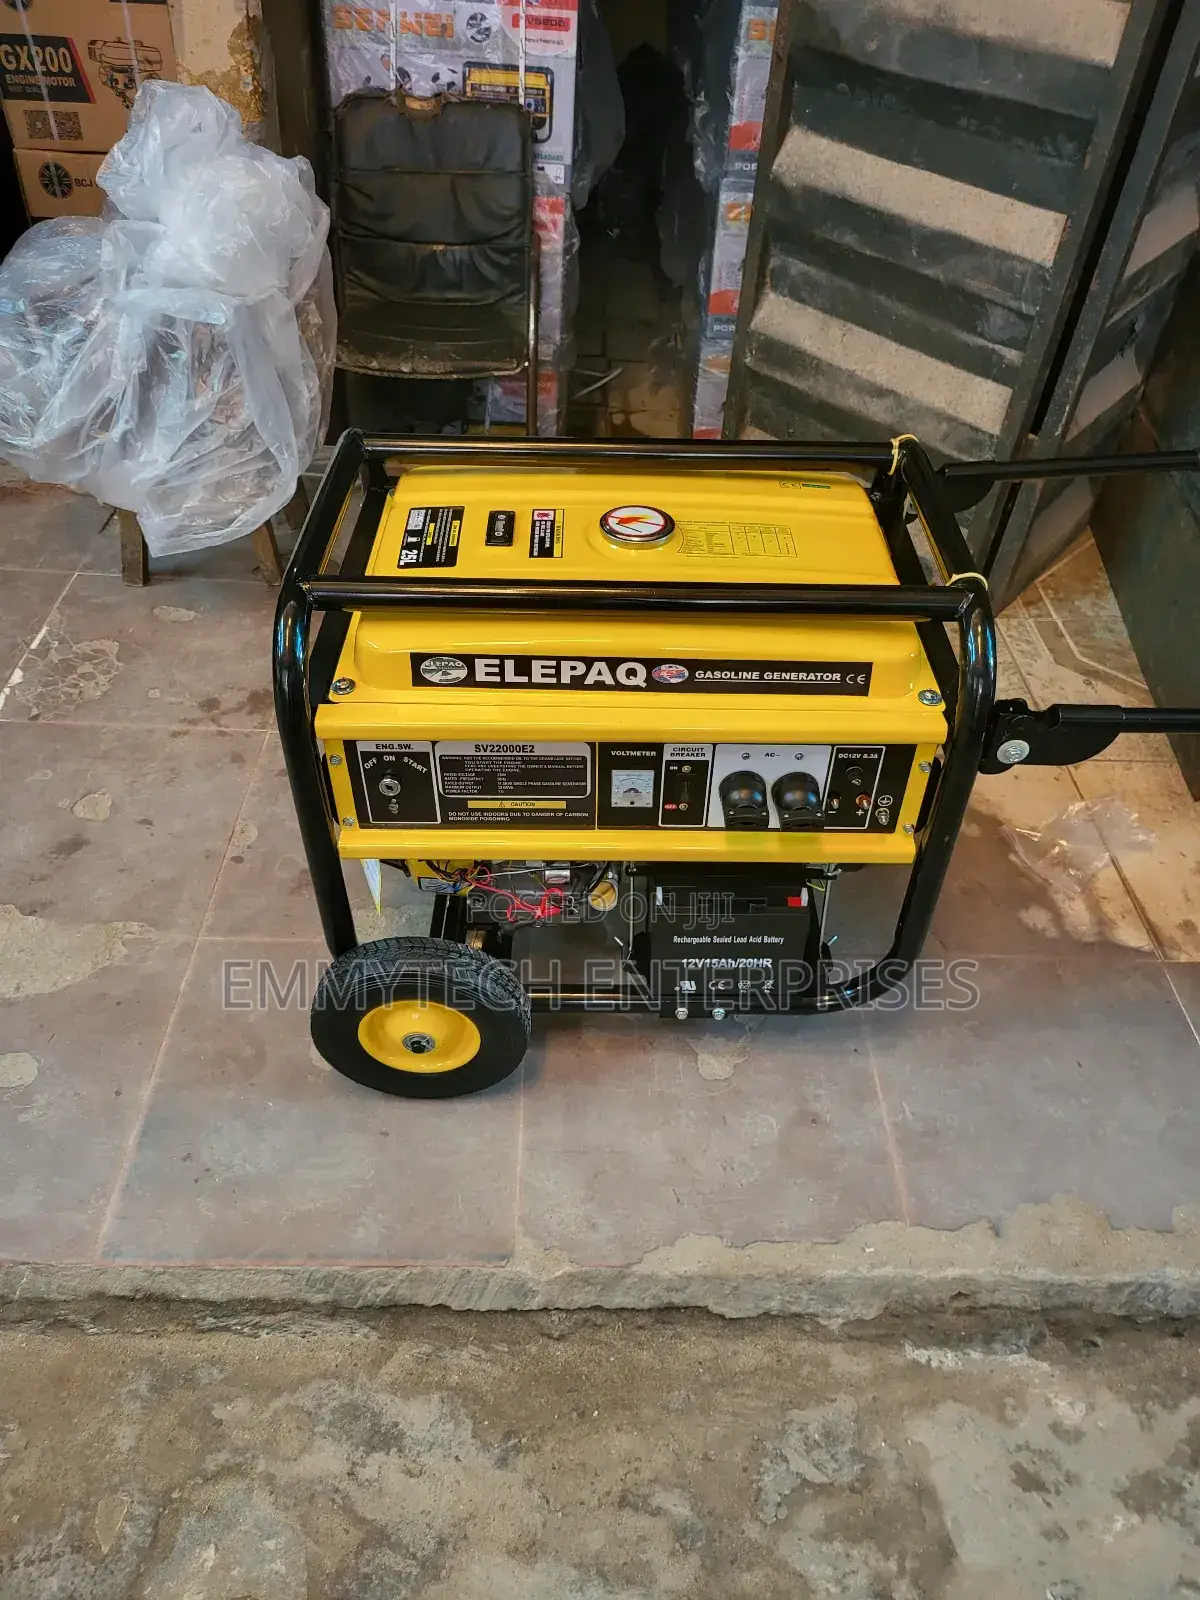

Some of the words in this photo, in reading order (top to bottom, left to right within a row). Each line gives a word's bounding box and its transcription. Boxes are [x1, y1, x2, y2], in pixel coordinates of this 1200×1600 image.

[0, 44, 72, 73] GX200
[5, 74, 41, 85] ENGINE
[74, 178, 93, 187] BCJ
[399, 549, 418, 566] 25L
[474, 658, 647, 688] ELEPAQ
[695, 670, 760, 680] GASOLINE
[763, 671, 841, 681] GENERATOR
[475, 744, 535, 753] SV22000E2
[364, 757, 378, 769] OFF
[402, 756, 428, 774] START
[673, 935, 711, 945] Rechargeable
[712, 935, 732, 943] Sealed
[763, 936, 784, 945] Battery
[682, 958, 773, 969] 12V15Ah/20HR
